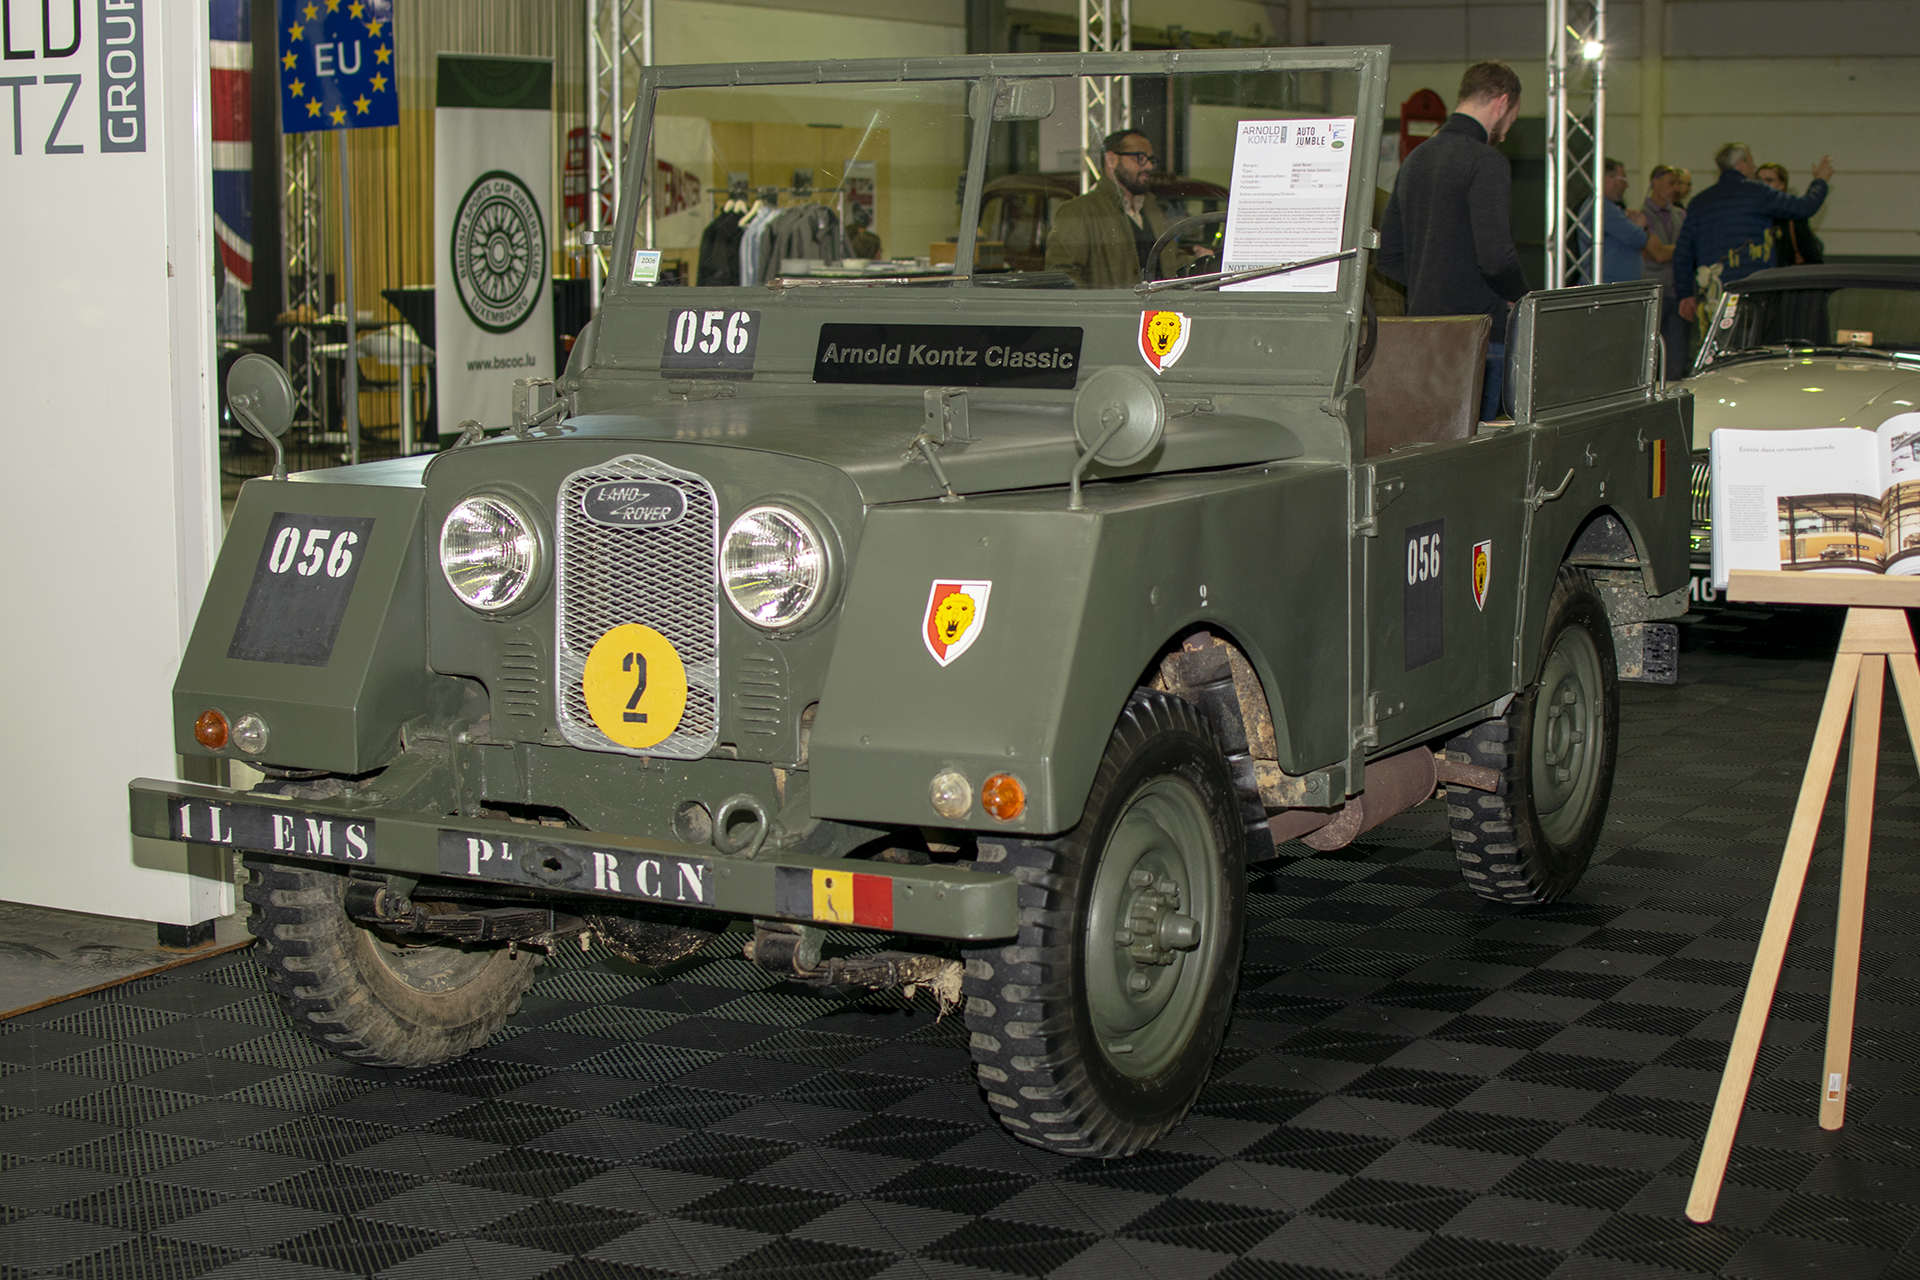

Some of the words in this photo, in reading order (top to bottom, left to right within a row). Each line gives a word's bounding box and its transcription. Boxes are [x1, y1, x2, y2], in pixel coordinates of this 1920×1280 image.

[315, 39, 361, 77] EU
[0, 73, 84, 155] TZ
[1242, 125, 1280, 135] ARNOLD
[1247, 135, 1280, 144] KONTZ
[1295, 136, 1326, 146] JUMBLE
[1296, 126, 1316, 136] AUTO
[458, 223, 467, 279] BRITISH
[464, 183, 492, 221] SPORTS
[493, 181, 511, 196] CAR
[513, 189, 539, 240] OWNERS
[532, 243, 540, 280] CLUB
[1228, 264, 1247, 272] NOT
[470, 296, 528, 323] LUXEMBOURG
[673, 310, 751, 354] 056
[466, 354, 536, 372] www.bscoc.lu
[821, 342, 901, 365] Arnold
[907, 343, 978, 367] Kontz
[984, 345, 1074, 370] Classic
[1813, 443, 1836, 451] monde
[597, 488, 640, 501] LAND
[622, 506, 672, 521] ROVER
[268, 526, 358, 578] 056
[1407, 533, 1441, 586] 056
[622, 652, 648, 723] 2
[272, 814, 369, 860] EMS
[592, 852, 705, 902] RCN
